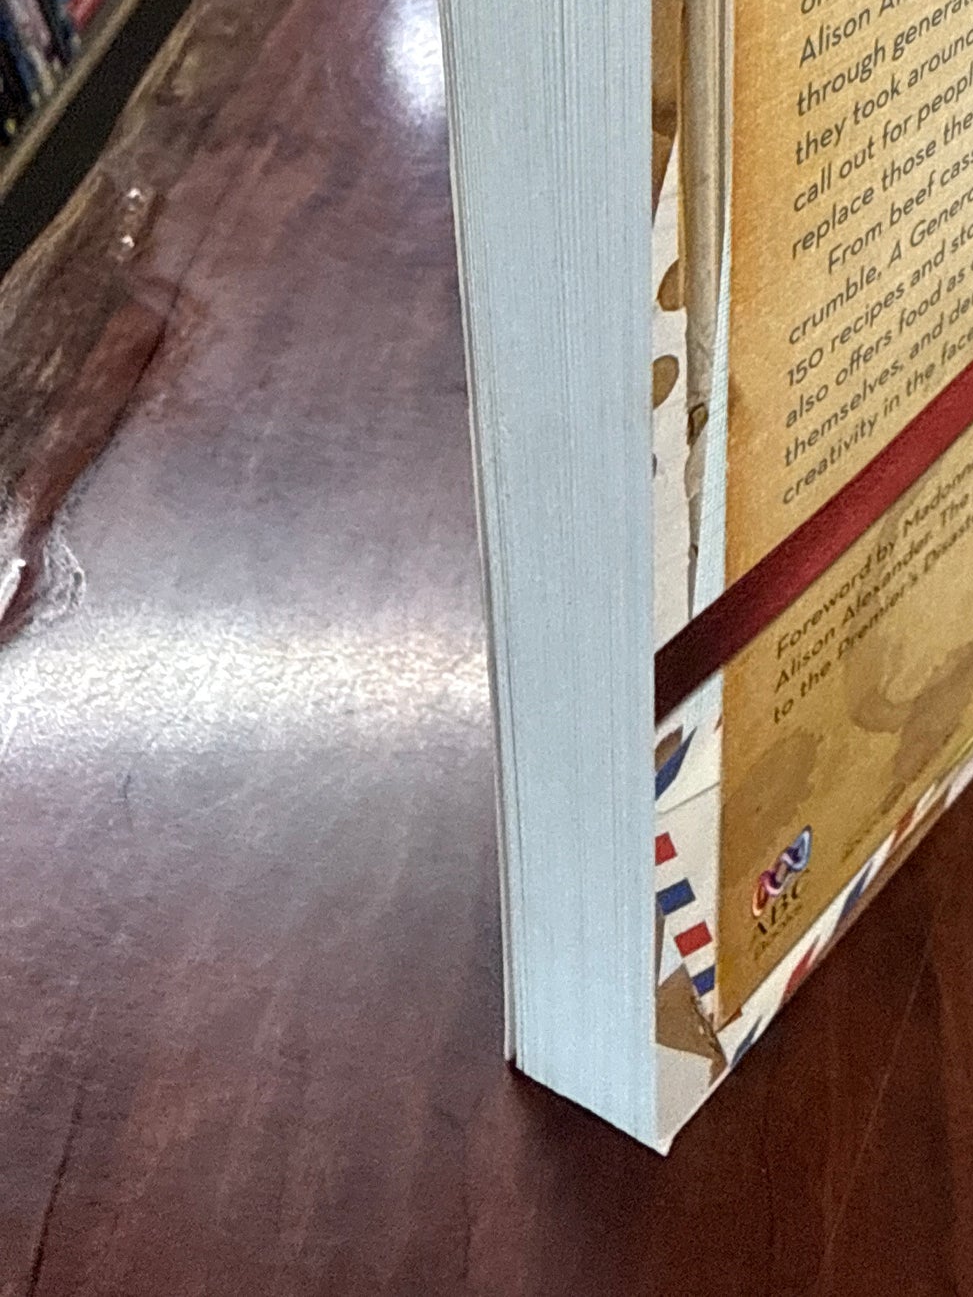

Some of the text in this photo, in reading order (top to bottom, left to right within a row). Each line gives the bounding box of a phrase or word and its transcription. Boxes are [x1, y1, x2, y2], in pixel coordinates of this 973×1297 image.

[796, 30, 886, 118] through
[799, 1, 871, 66] Alison
[793, 158, 832, 213] call
[838, 131, 875, 181] out
[881, 111, 911, 150] for
[795, 112, 845, 166] they
[852, 65, 901, 126] took
[791, 180, 874, 259] replace
[880, 134, 936, 193] those
[827, 215, 882, 275] From
[888, 167, 934, 227] beef
[787, 342, 824, 388] 150
[830, 276, 904, 353] recipes
[910, 235, 946, 287] and
[788, 261, 881, 347] crumble,
[887, 234, 902, 268] A
[784, 355, 902, 468] themselves,
[909, 307, 944, 360] and
[785, 377, 829, 430] also
[835, 324, 892, 388] offers
[897, 274, 942, 335] food
[946, 263, 965, 293] as
[782, 406, 878, 506] creativity
[883, 386, 900, 416] in
[905, 355, 935, 396] the
[774, 621, 835, 694] Alison
[776, 550, 872, 661] Foreword
[773, 693, 793, 726] to
[800, 655, 831, 699] the
